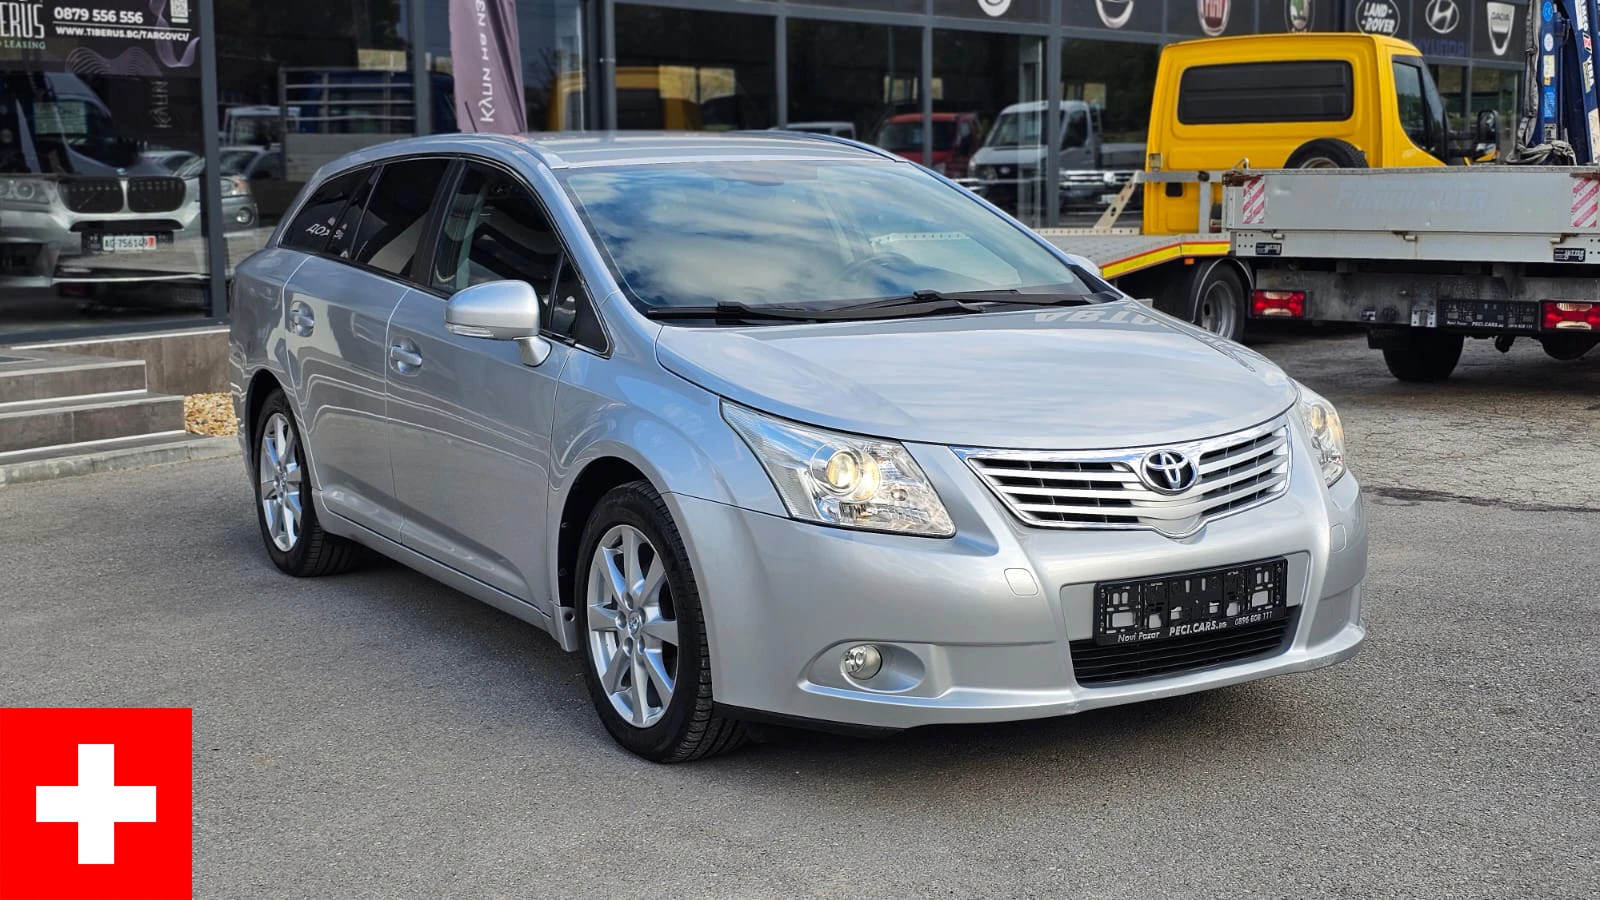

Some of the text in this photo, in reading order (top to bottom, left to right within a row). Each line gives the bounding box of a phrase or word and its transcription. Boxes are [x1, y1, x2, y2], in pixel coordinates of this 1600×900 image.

[54, 7, 144, 24] 0879 556 556
[1363, 3, 1388, 18] LAND
[1365, 18, 1396, 34] ROVER
[4, 40, 46, 50] LEASING
[1117, 631, 1137, 643] Novi
[1138, 630, 1161, 641] Pazar
